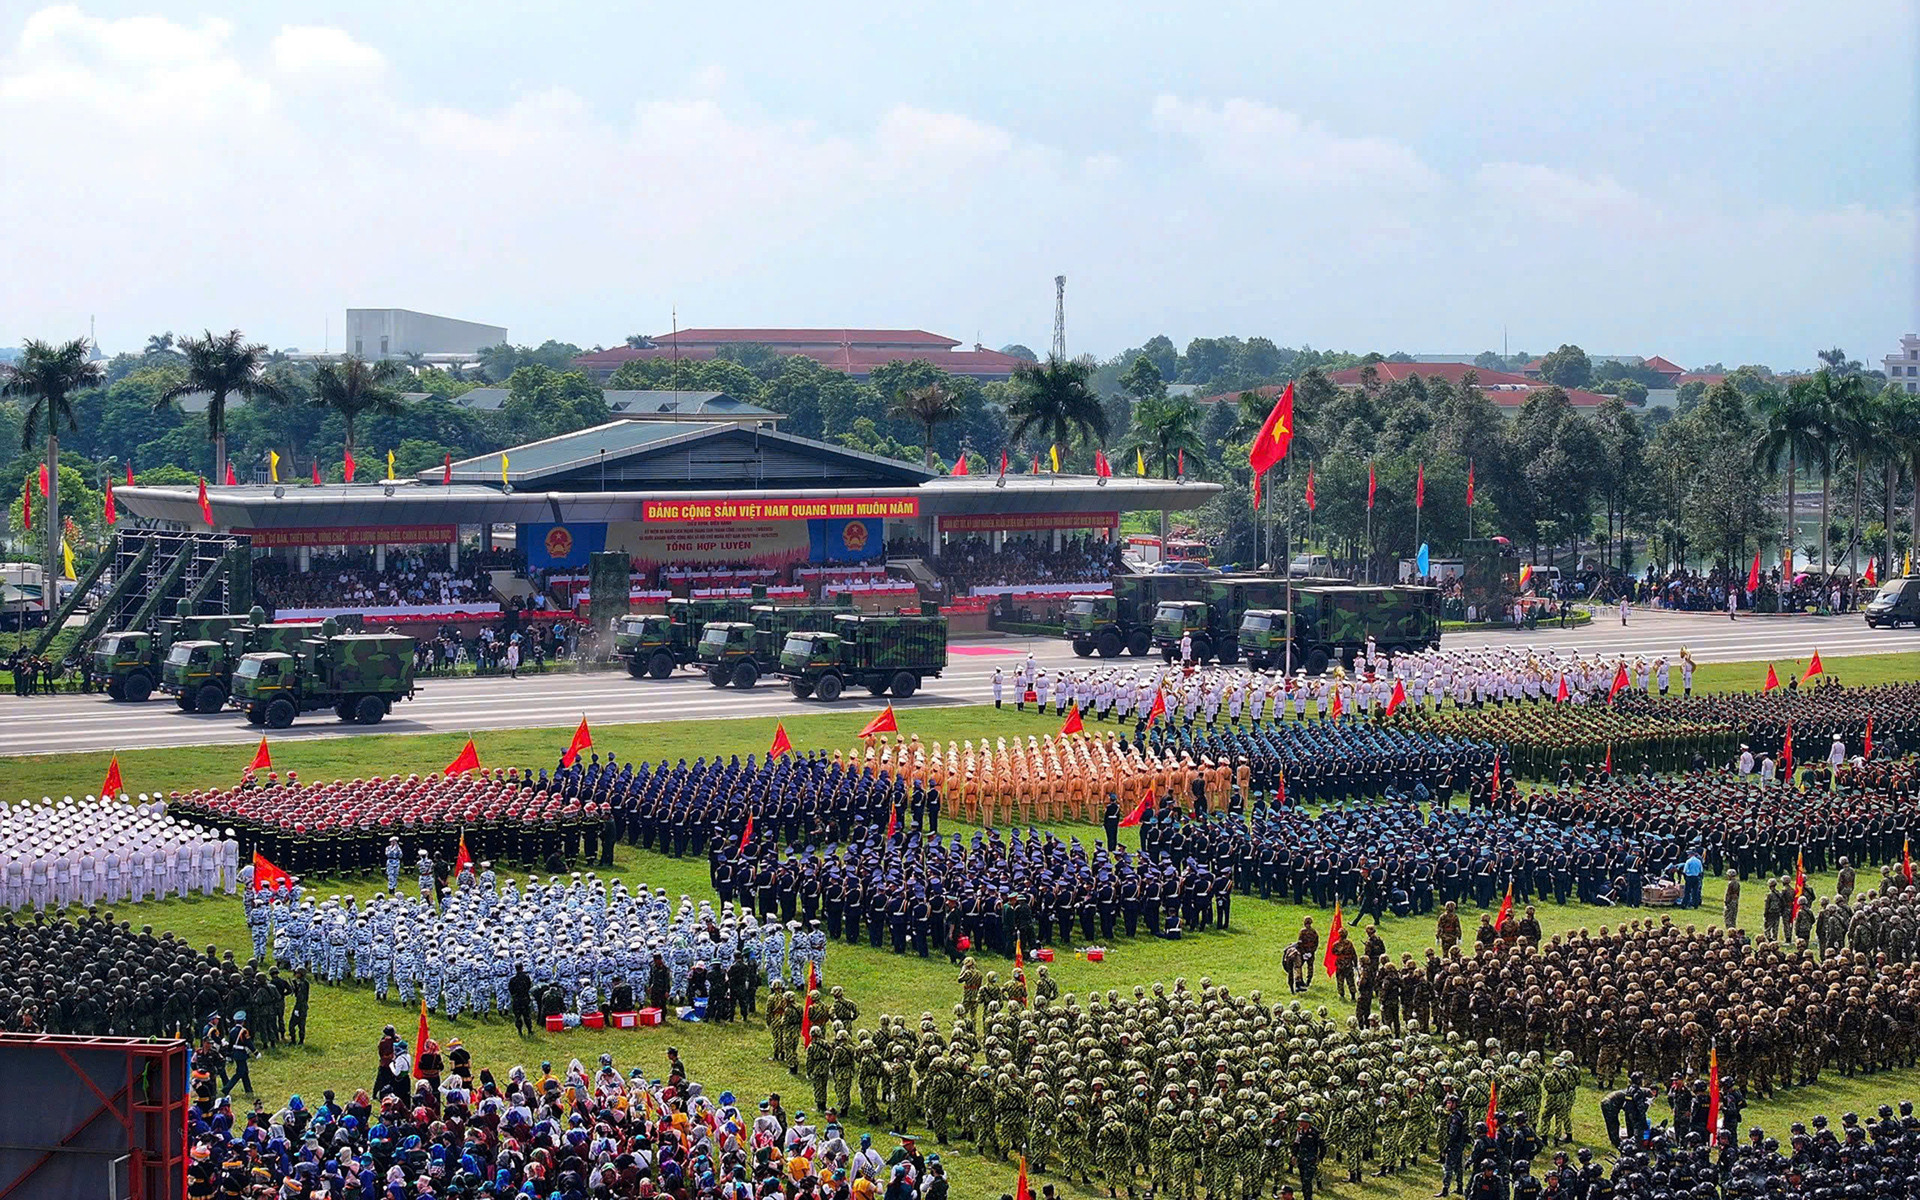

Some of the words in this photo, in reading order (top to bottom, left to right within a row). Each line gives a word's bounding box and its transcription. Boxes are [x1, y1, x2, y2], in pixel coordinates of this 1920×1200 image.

[648, 502, 679, 518] ĐẢNG
[681, 504, 711, 520] CỘNG
[714, 501, 736, 517] SẢN
[739, 503, 762, 519] VIỆT
[764, 505, 789, 516] NAM
[791, 504, 827, 517] QUANG
[829, 503, 854, 515] VINH
[856, 501, 887, 515] MUÔN
[889, 501, 913, 514] NĂM
[666, 540, 693, 551] TỔNG
[696, 541, 717, 552] HỢP
[720, 540, 751, 551] LUYỆN
